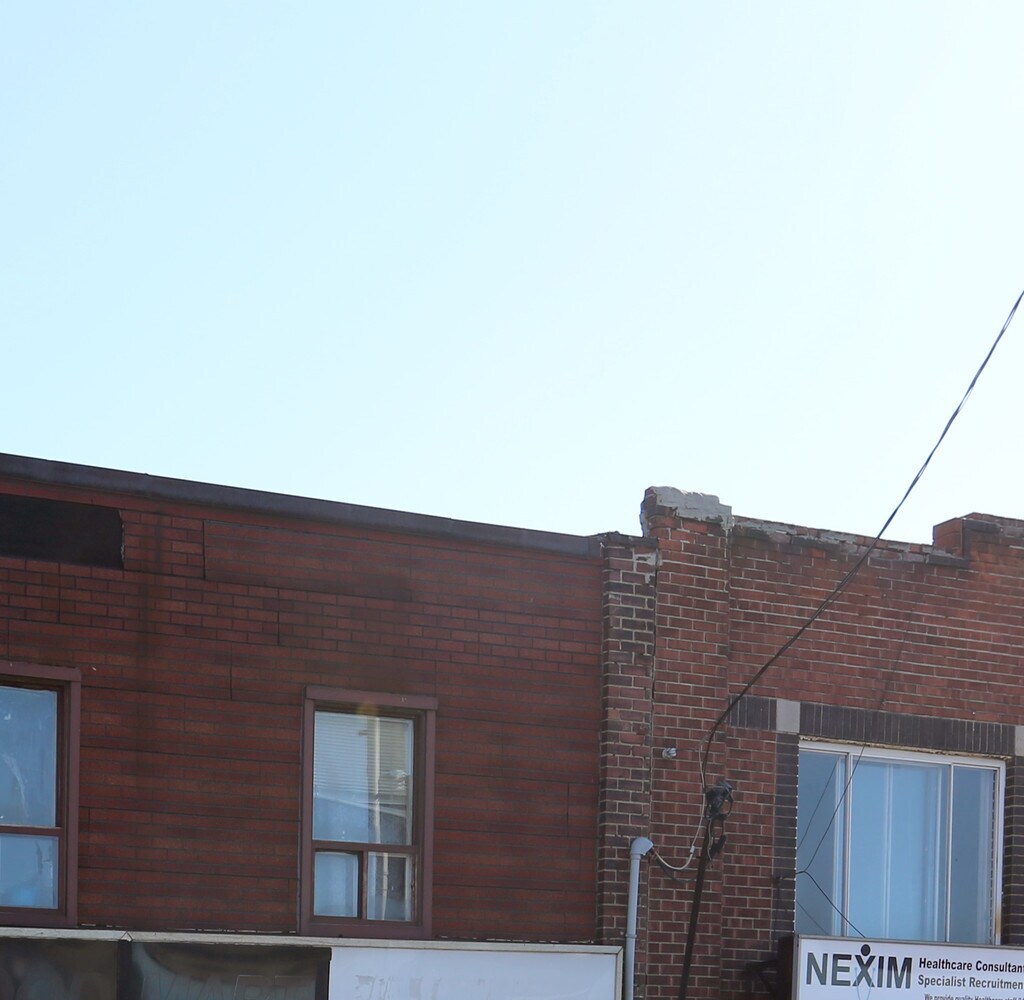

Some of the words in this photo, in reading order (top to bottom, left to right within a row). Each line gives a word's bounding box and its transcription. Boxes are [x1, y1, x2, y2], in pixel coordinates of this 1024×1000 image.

[806, 946, 912, 989] NEXIM
[919, 957, 973, 971] Healthcare
[918, 974, 966, 988] Specialist
